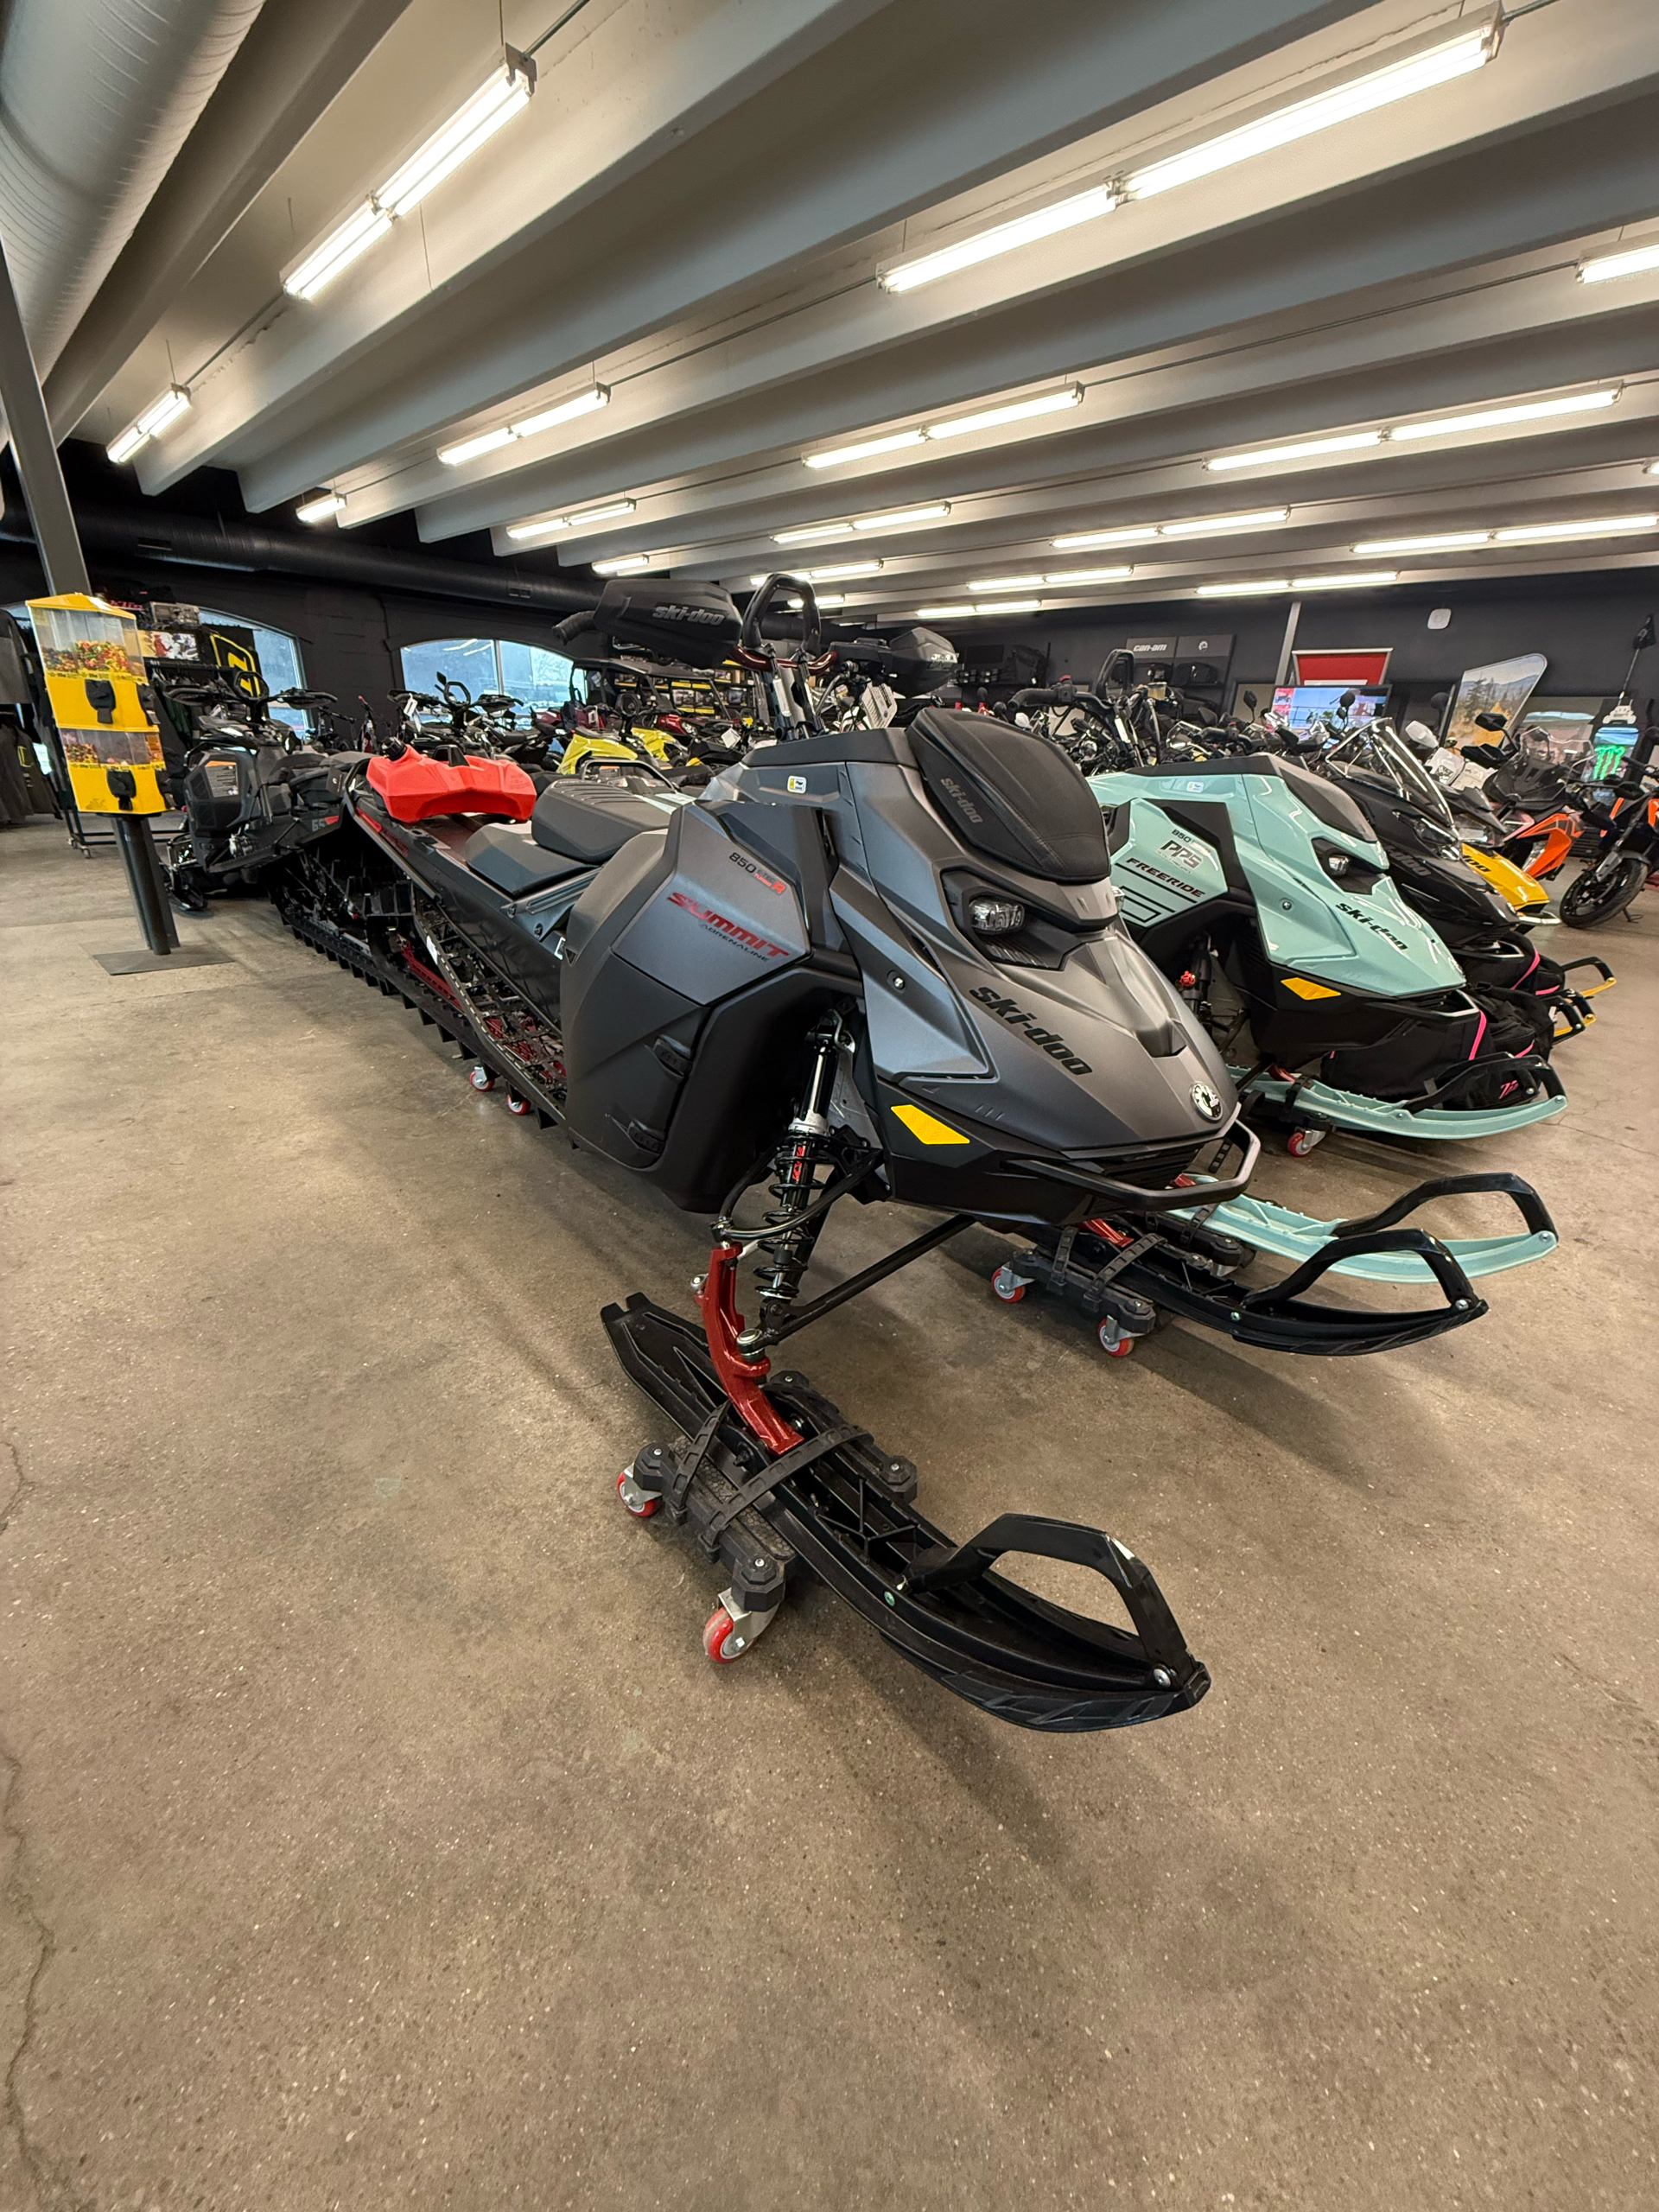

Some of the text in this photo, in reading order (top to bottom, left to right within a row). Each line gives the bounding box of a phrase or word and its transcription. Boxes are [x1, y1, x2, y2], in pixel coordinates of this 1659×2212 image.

[652, 605, 725, 626] ski-doo
[940, 778, 983, 823] ski-doo
[1172, 829, 1192, 843] 850
[728, 852, 757, 874] 850
[1125, 857, 1206, 898] FREERIDE
[667, 892, 790, 957] SUMMIT
[699, 924, 770, 963] ADRENALINE
[1335, 902, 1408, 950] ski-doo
[969, 987, 1093, 1076] ski-doo
